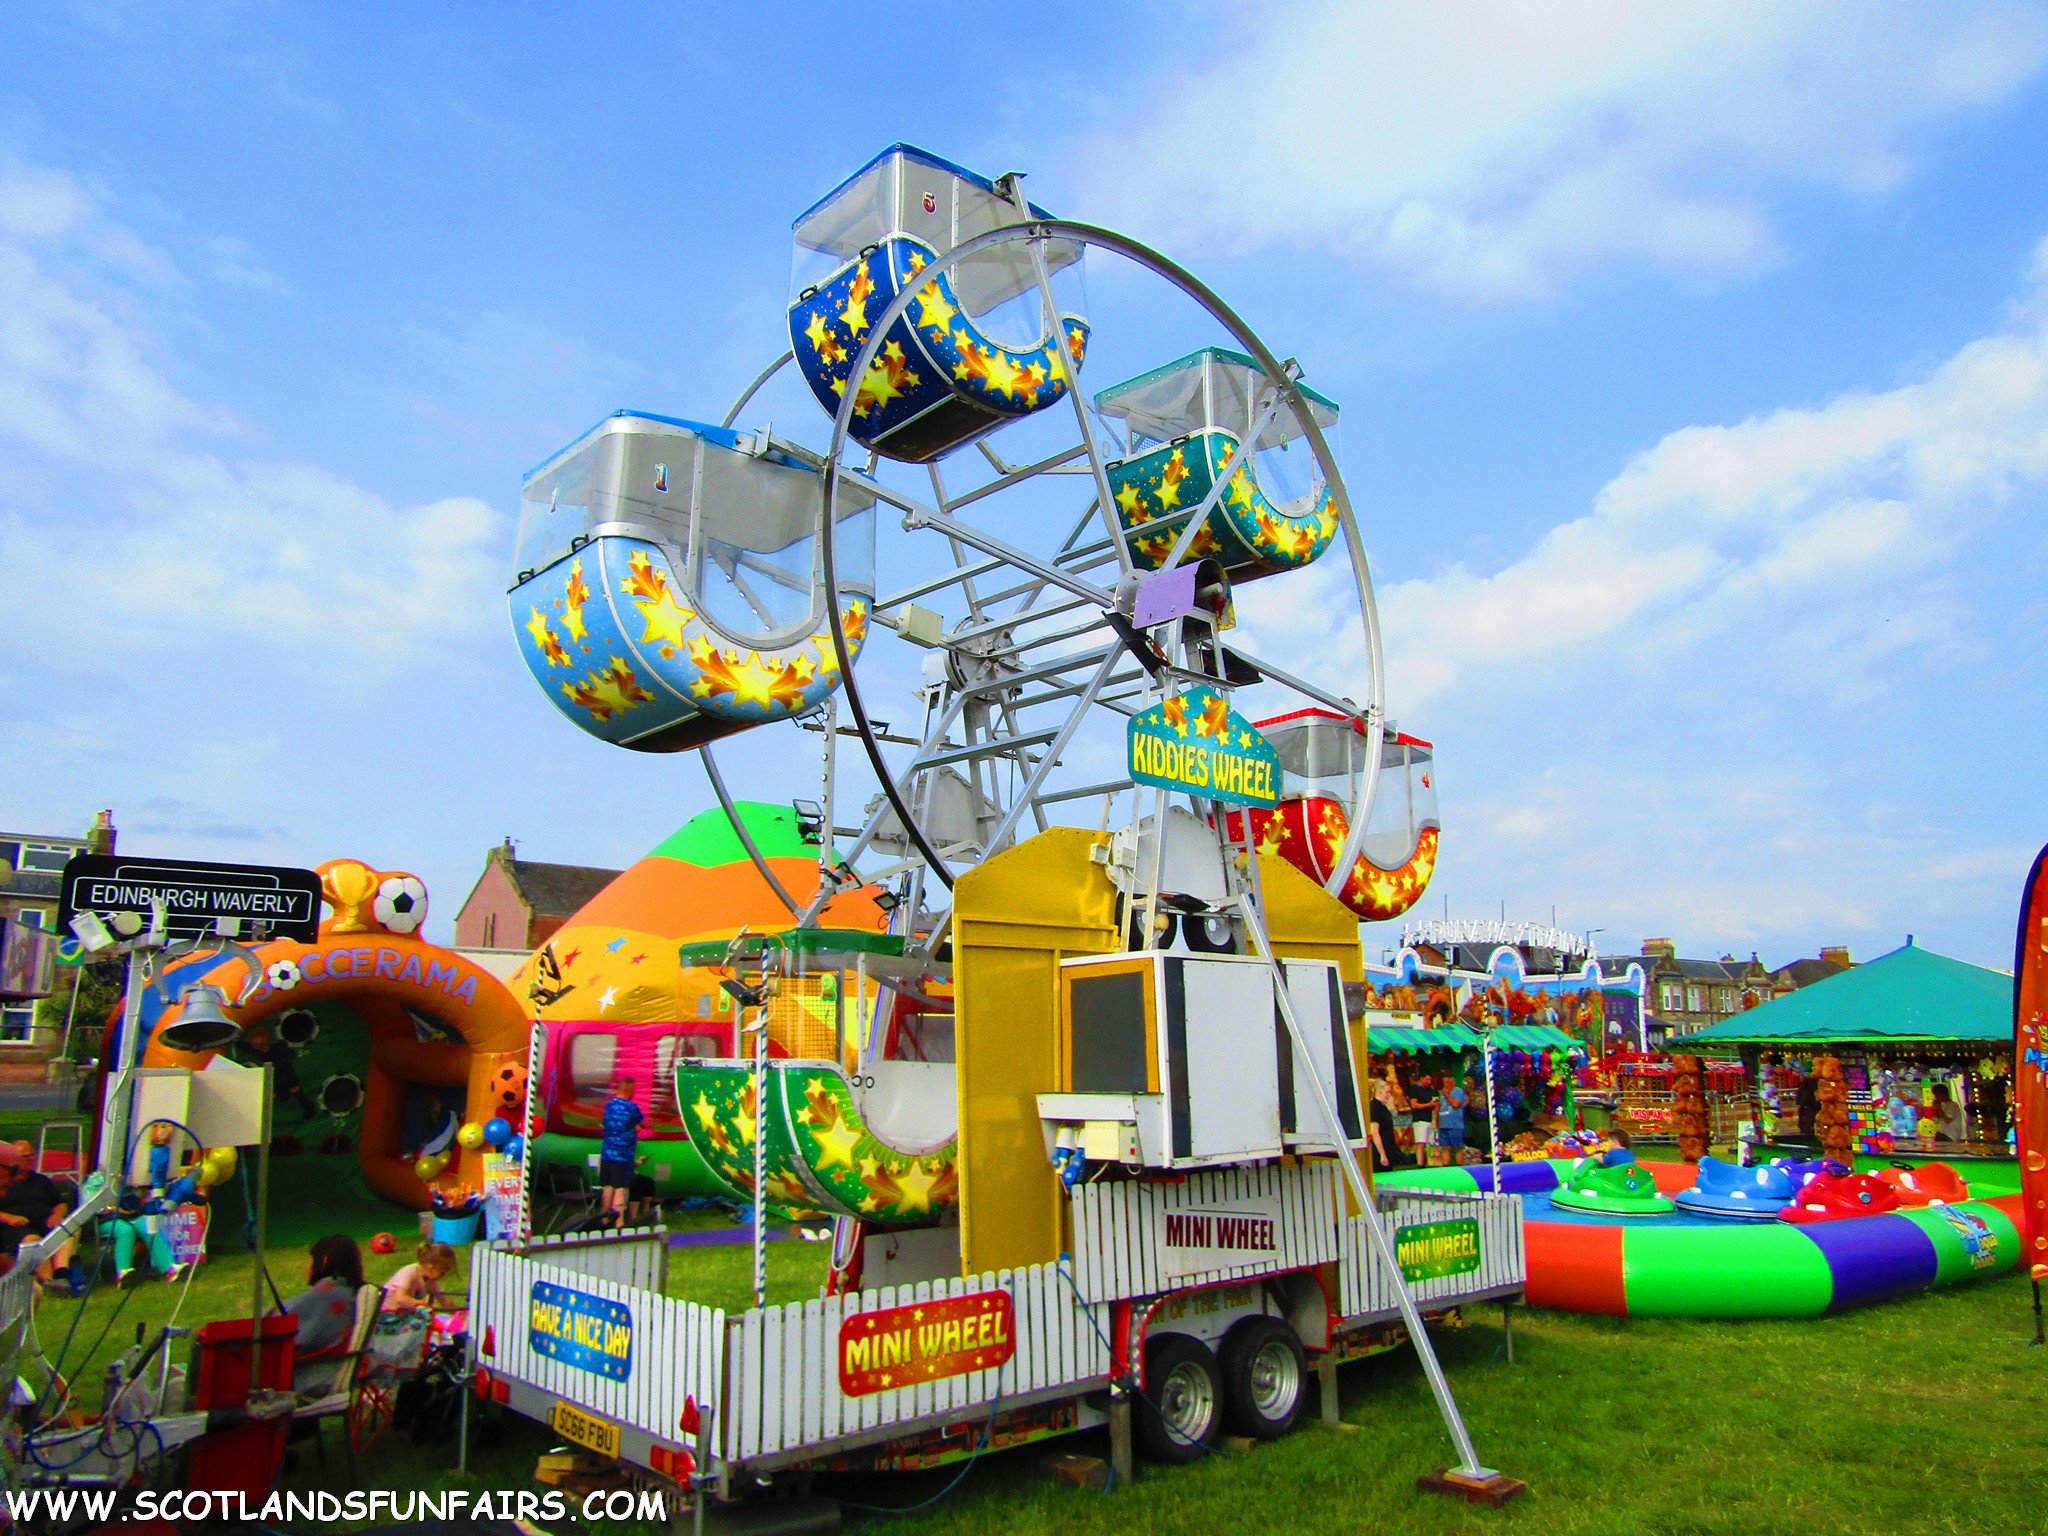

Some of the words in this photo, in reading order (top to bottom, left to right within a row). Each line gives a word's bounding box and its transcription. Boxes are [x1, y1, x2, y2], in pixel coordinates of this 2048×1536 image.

[923, 191, 936, 214] 5
[654, 463, 668, 493] 1
[1133, 732, 1209, 788] KIDDIES
[1212, 751, 1276, 801] WHEEL
[91, 885, 208, 909] EDINBURGH
[212, 891, 298, 914] WAVERLY
[1166, 1214, 1212, 1249] MINI
[1216, 1217, 1276, 1251] WHEEL
[1398, 1239, 1430, 1268] MINI
[1432, 1232, 1478, 1261] WHEEL
[531, 1299, 562, 1337] HAVE
[563, 1309, 572, 1341] A
[574, 1311, 604, 1351] NICE
[604, 1320, 631, 1360] DAY
[845, 1328, 912, 1376] MINI
[918, 1311, 1007, 1360] WHEEL
[559, 1407, 585, 1441] SC66
[588, 1422, 613, 1452] FBU
